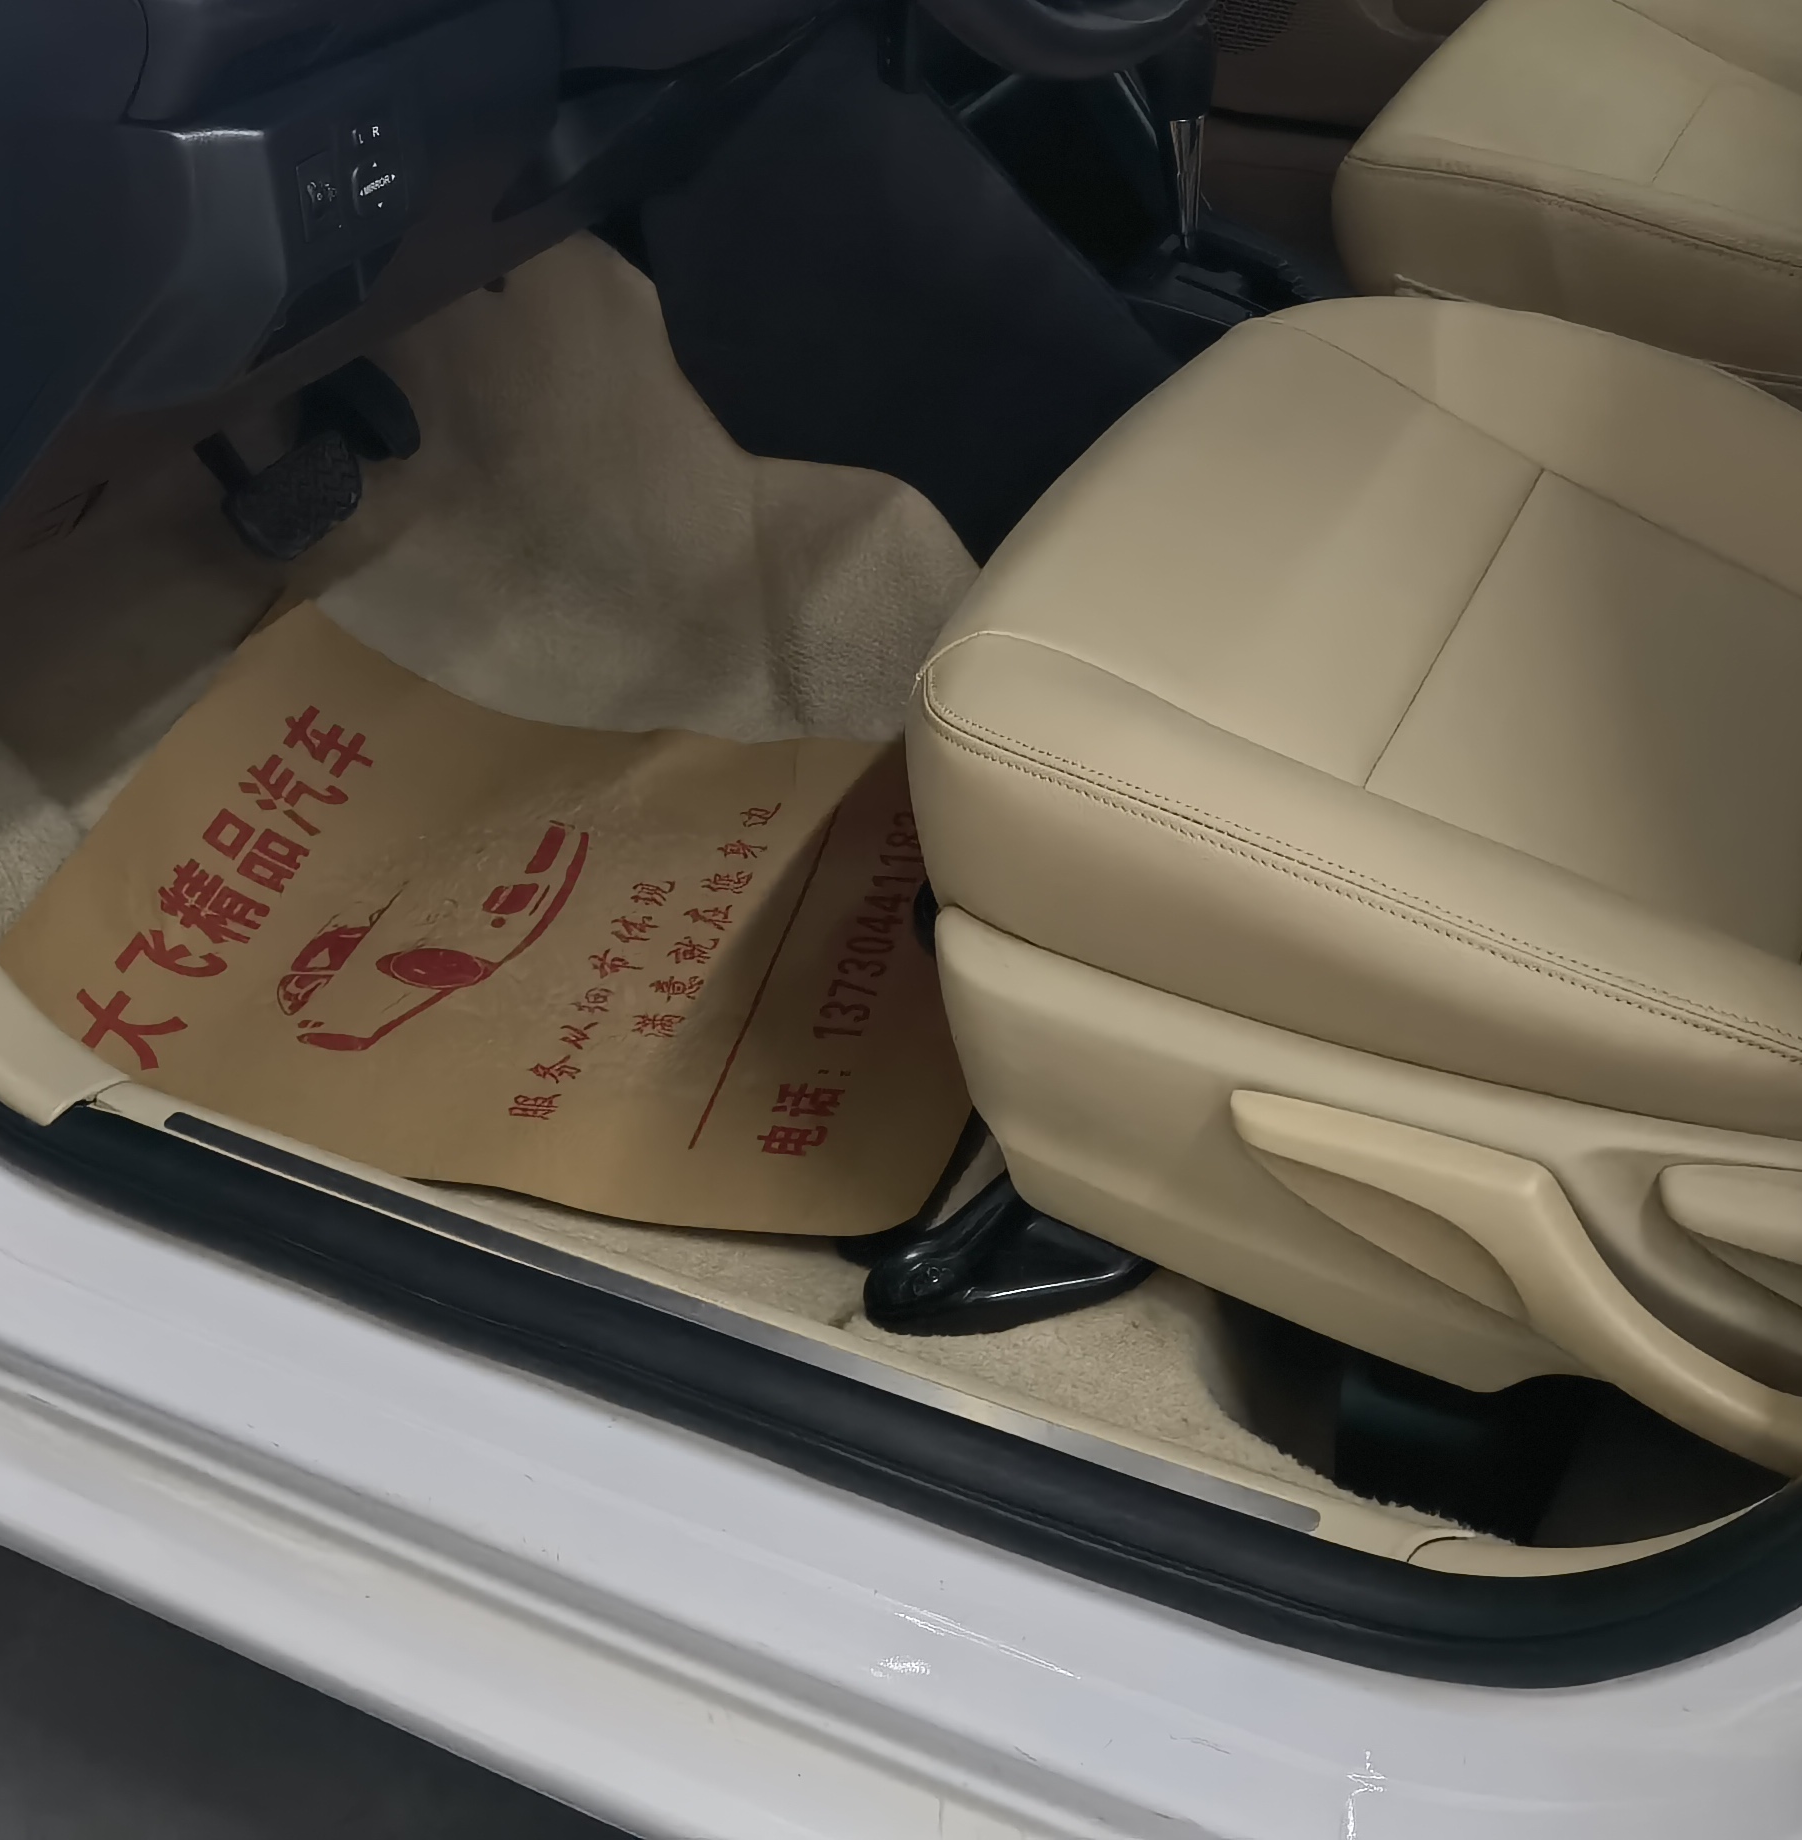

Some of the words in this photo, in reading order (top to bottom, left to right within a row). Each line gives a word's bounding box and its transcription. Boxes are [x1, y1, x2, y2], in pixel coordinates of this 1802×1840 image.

[372, 126, 380, 138] R
[76, 706, 374, 1071] 大飞精品汽车
